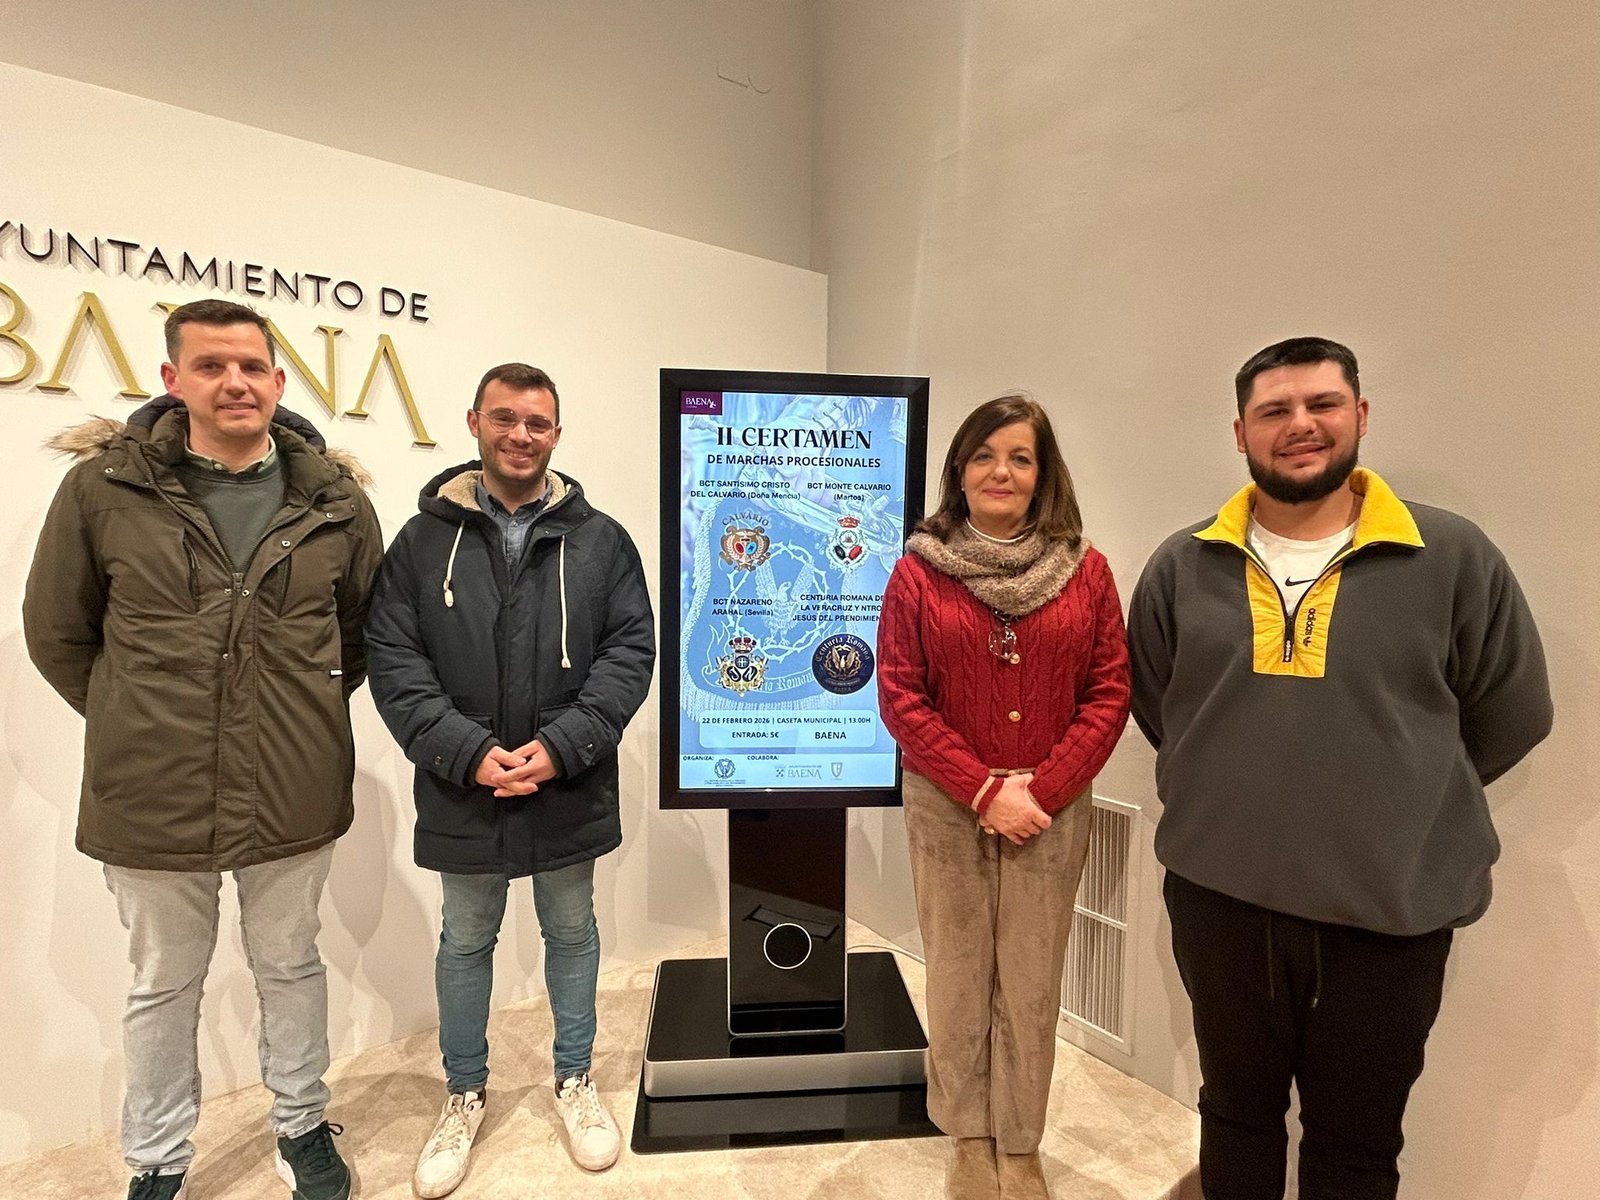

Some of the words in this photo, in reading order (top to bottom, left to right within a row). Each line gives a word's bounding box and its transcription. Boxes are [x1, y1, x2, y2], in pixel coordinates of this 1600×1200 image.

[0, 220, 363, 312] UNTAMIENTO
[380, 286, 429, 323] DE
[685, 397, 712, 407] BAENA
[717, 427, 732, 445] II
[742, 427, 872, 449] CERTAMEN
[707, 454, 722, 464] DE
[726, 454, 784, 465] MARCHAS
[787, 456, 881, 468] PROCESIONALES
[761, 481, 790, 489] CRISTO
[807, 482, 823, 490] BCT
[853, 483, 891, 491] CALVARIO
[690, 490, 705, 498] DEL
[833, 493, 865, 501] (Martos)
[722, 512, 769, 526] CALVARIO
[840, 594, 873, 602] ROMANA
[744, 608, 774, 617] (Sevilla)
[1305, 607, 1316, 636] adidas
[814, 731, 847, 740] BAENA
[788, 769, 822, 780] BAENA
